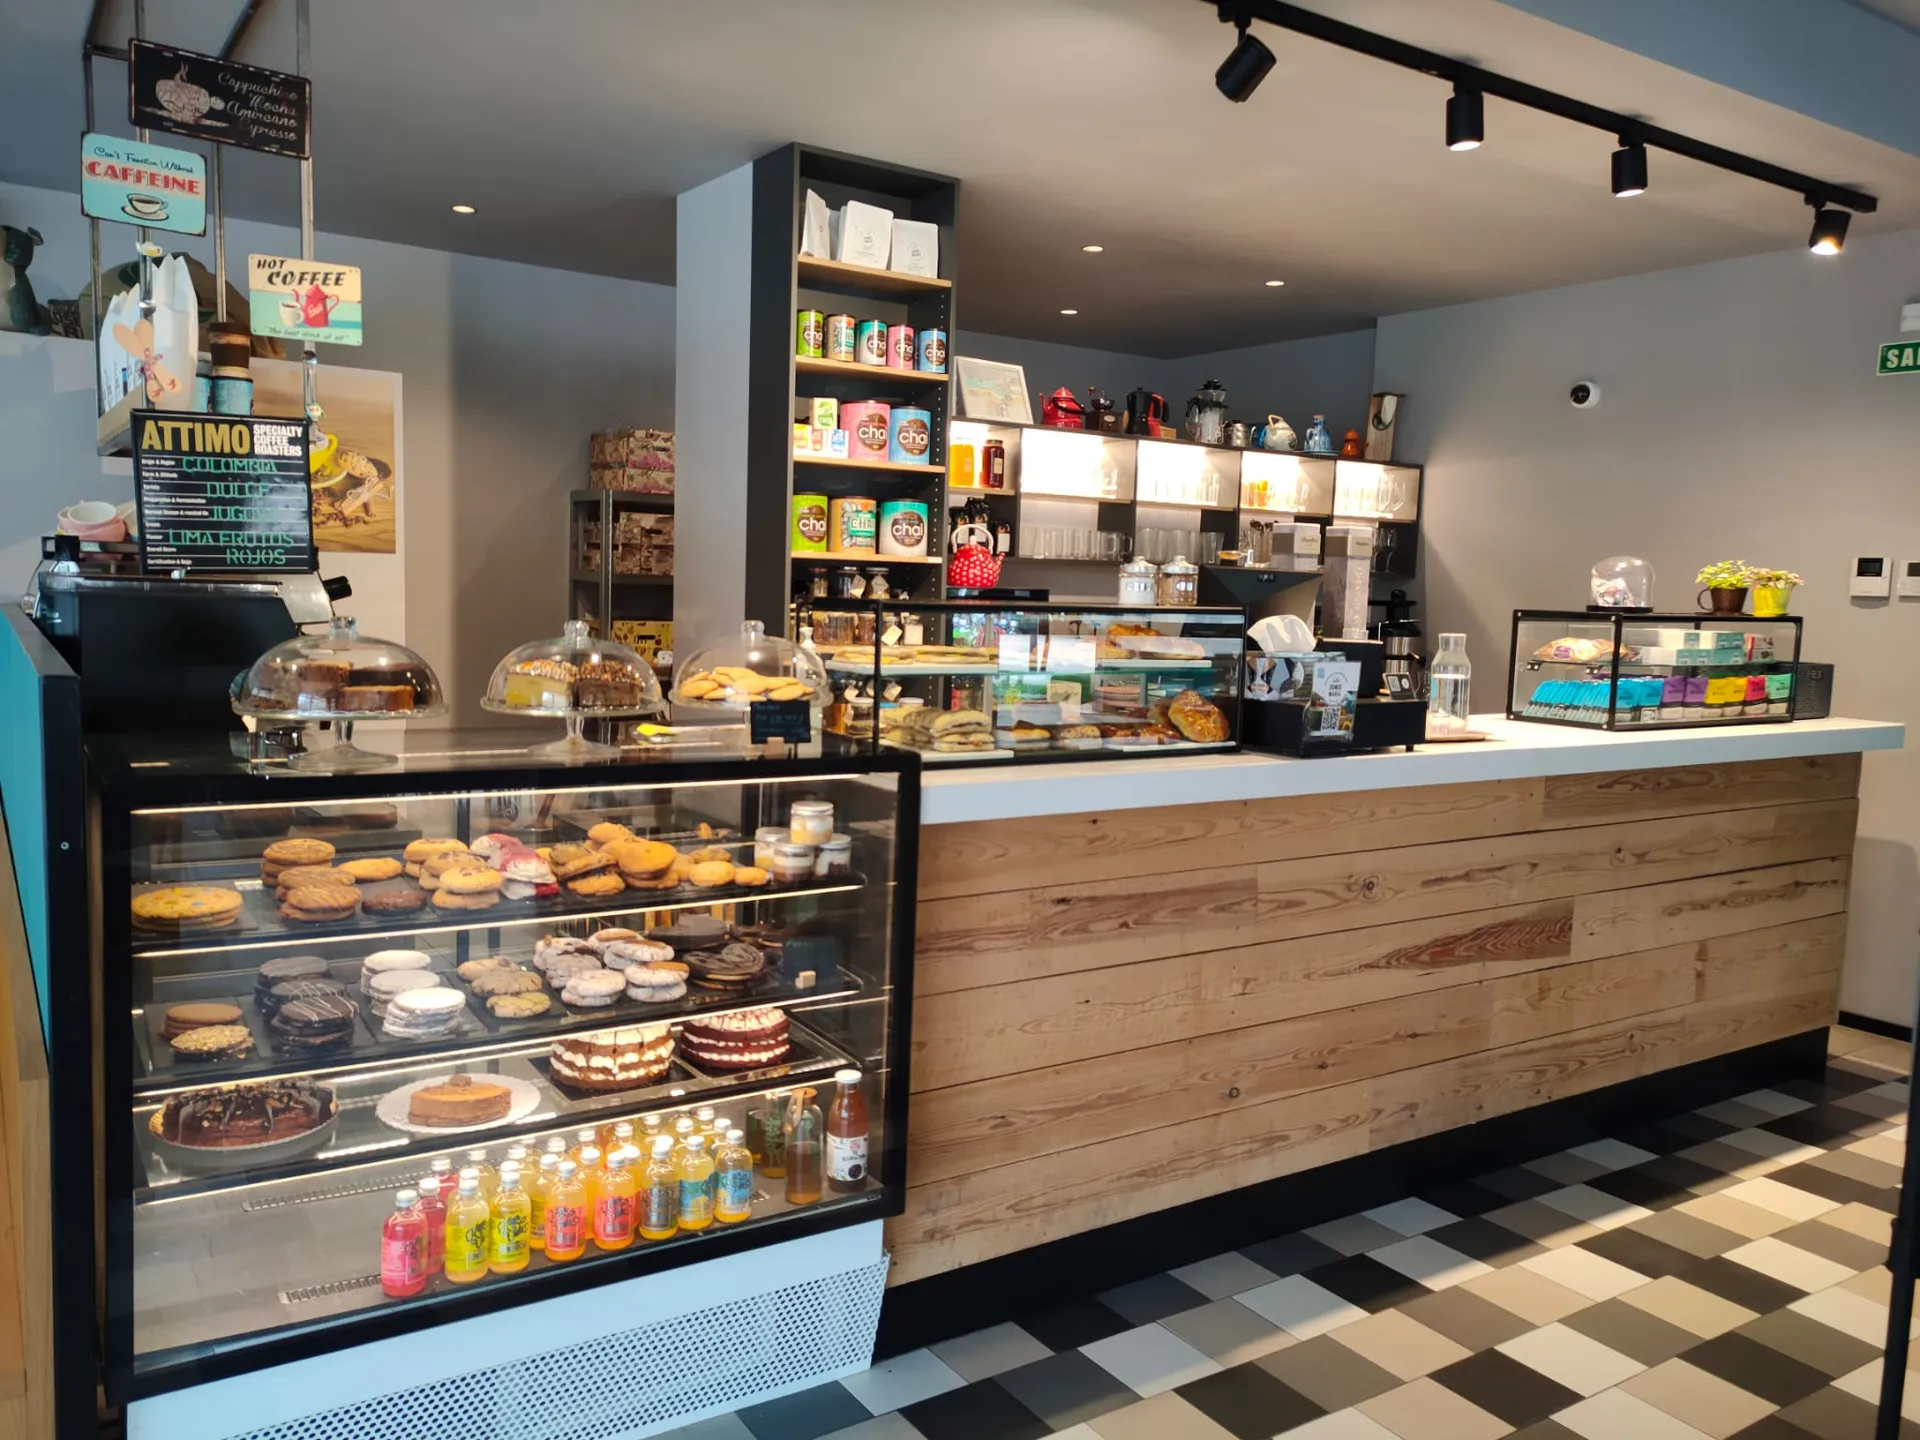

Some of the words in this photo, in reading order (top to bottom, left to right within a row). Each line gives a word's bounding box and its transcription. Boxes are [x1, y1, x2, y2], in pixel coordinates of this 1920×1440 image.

[87, 161, 200, 195] CAFFEINE
[257, 259, 287, 269] HOT
[267, 271, 347, 286] COFFEE
[141, 420, 250, 455] ATTIMO
[253, 424, 303, 437] SPECIALTY
[254, 435, 288, 446] COFFEE
[254, 445, 302, 457] ROASTERS
[183, 456, 278, 475] COLOMBIA
[207, 482, 271, 498] DULCE
[893, 522, 924, 536] chai
[169, 529, 214, 546] LIMA
[219, 531, 295, 547] FRUTOS
[226, 548, 286, 565] ROJOS
